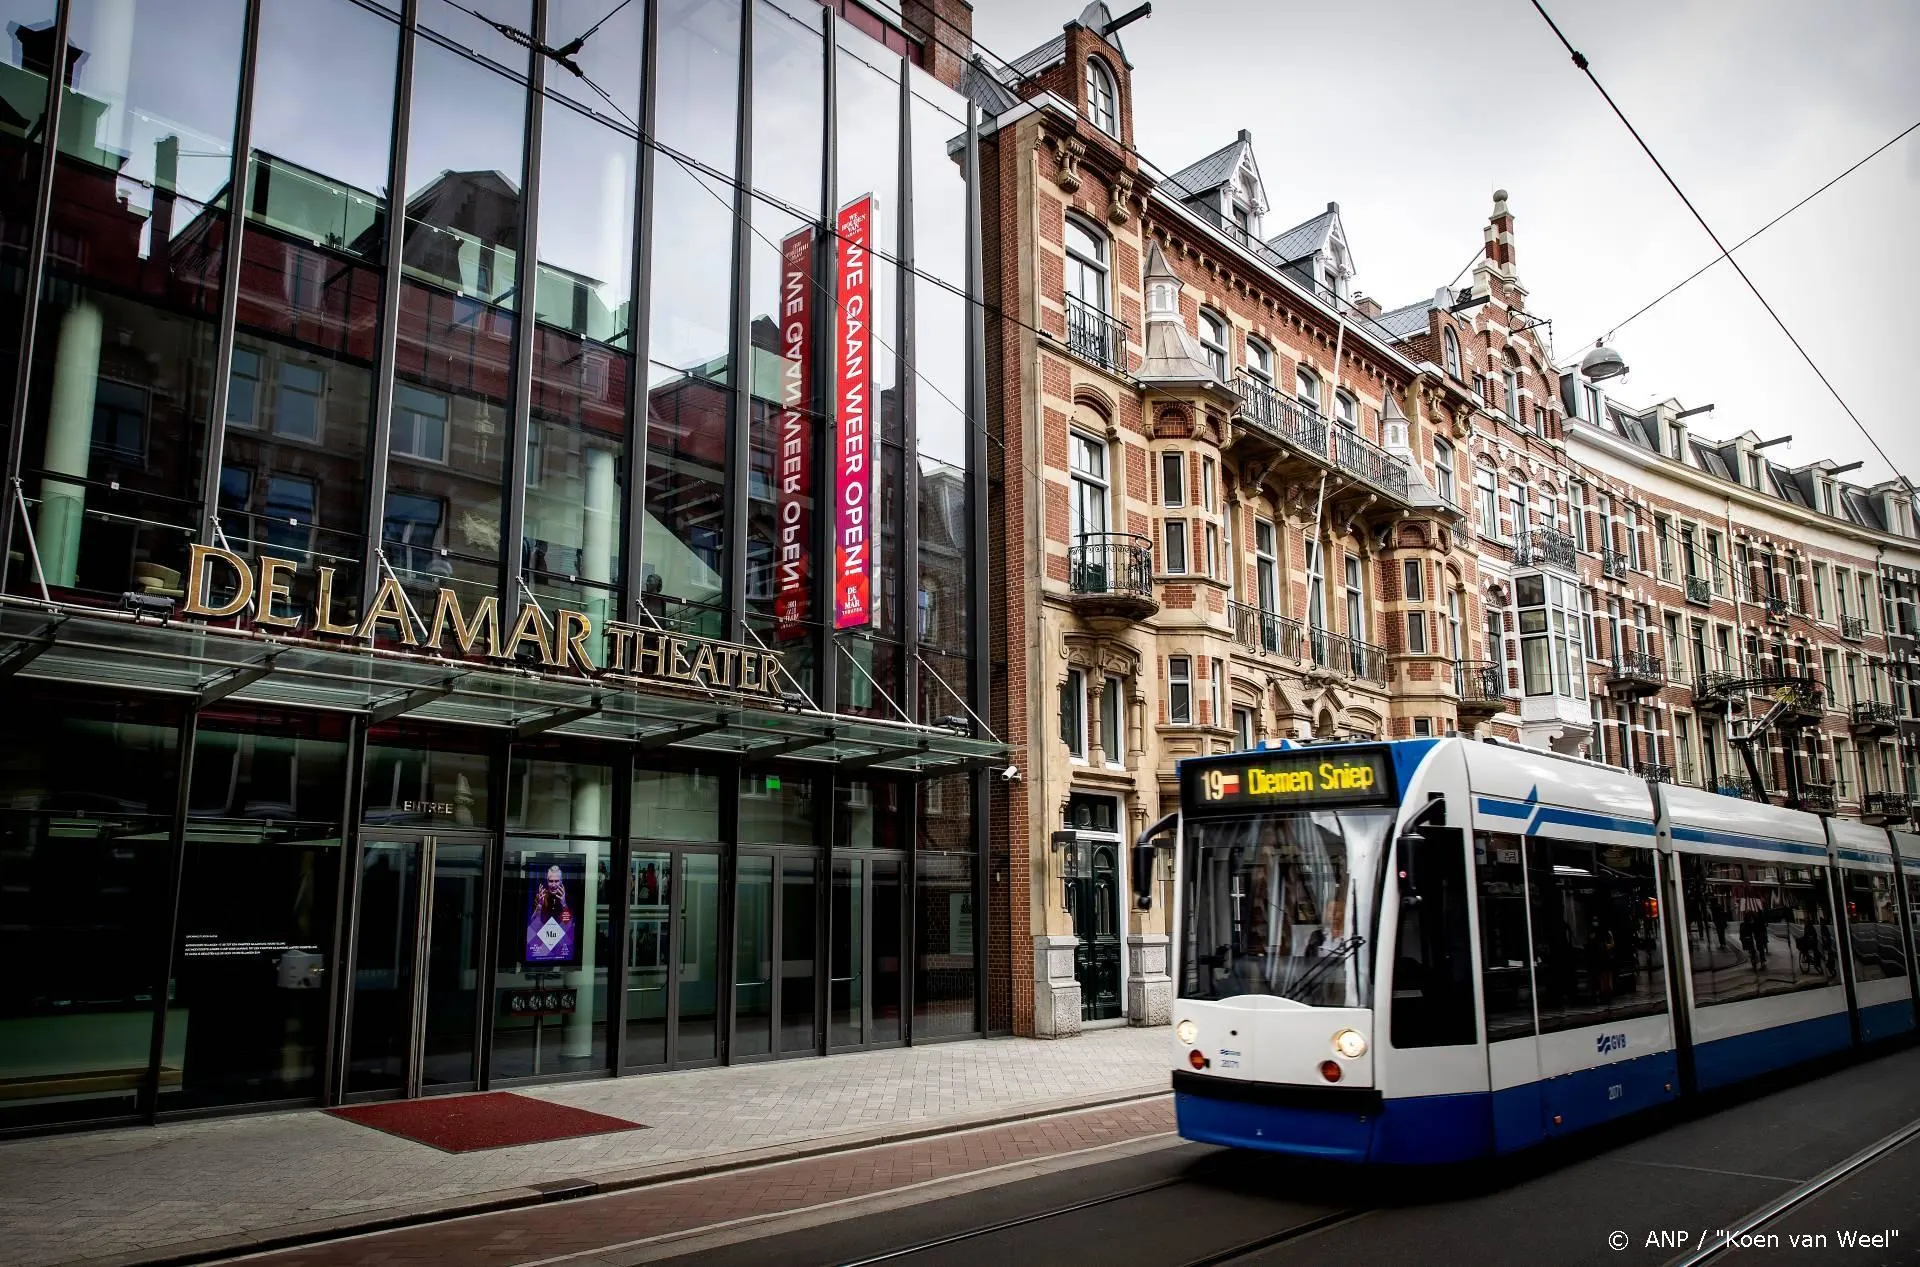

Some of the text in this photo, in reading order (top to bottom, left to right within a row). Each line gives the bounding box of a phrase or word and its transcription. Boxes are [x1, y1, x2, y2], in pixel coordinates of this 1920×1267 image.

[845, 238, 863, 576] WE GAAN WEER OPEN!
[607, 626, 784, 696] THEATER
[1201, 762, 1374, 801] 19 Diemen Sniep
[403, 800, 454, 814] ENTREE
[1611, 1034, 1626, 1049] GVB
